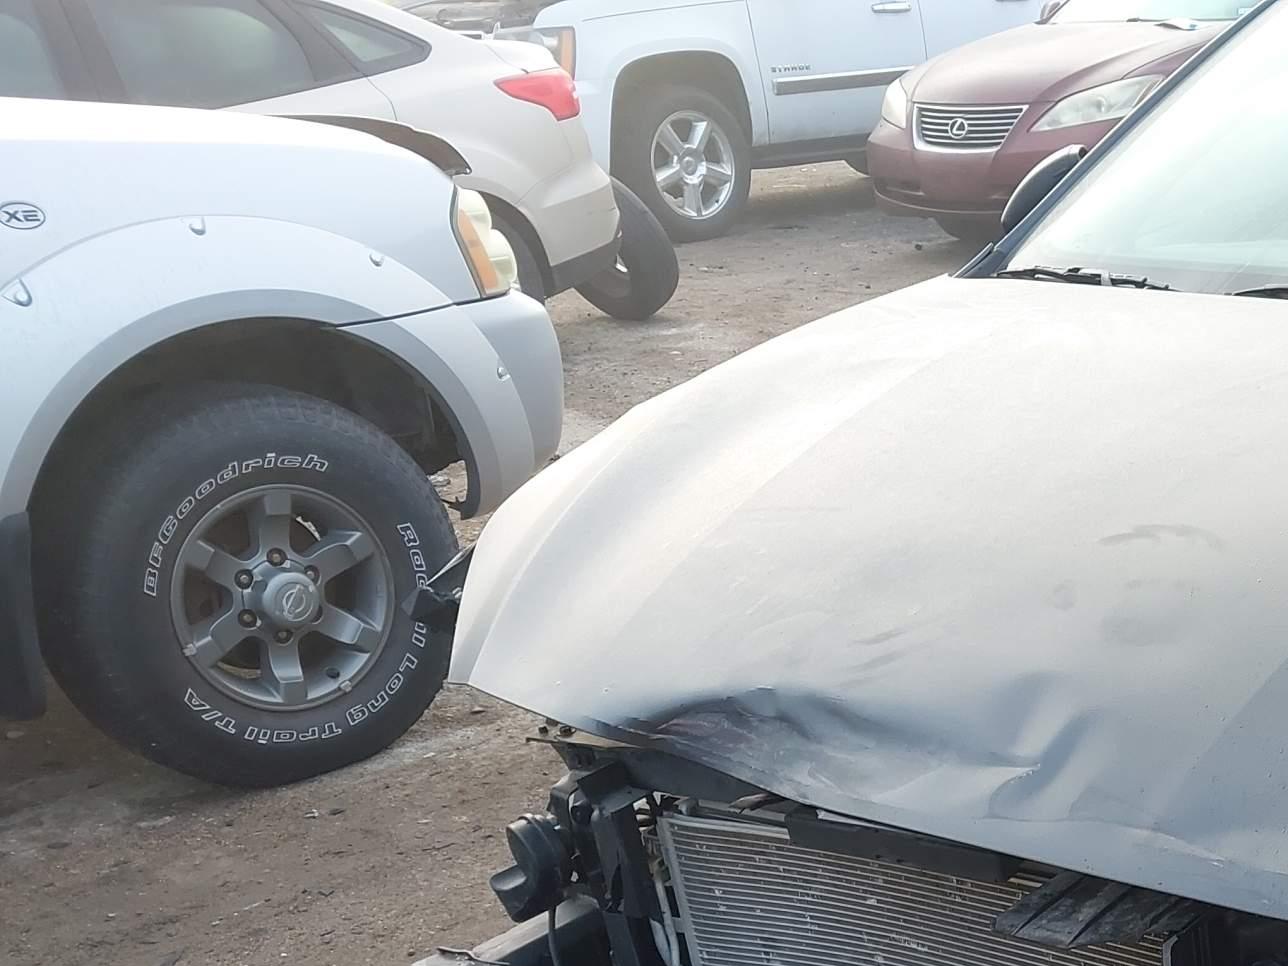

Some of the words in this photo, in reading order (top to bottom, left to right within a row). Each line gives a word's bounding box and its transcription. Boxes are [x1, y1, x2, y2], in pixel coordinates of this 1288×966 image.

[1, 209, 41, 223] XE
[144, 452, 330, 599] BFGoodrich
[183, 687, 240, 736] T/A
[346, 655, 419, 727] Long
[243, 720, 343, 746] Trail
